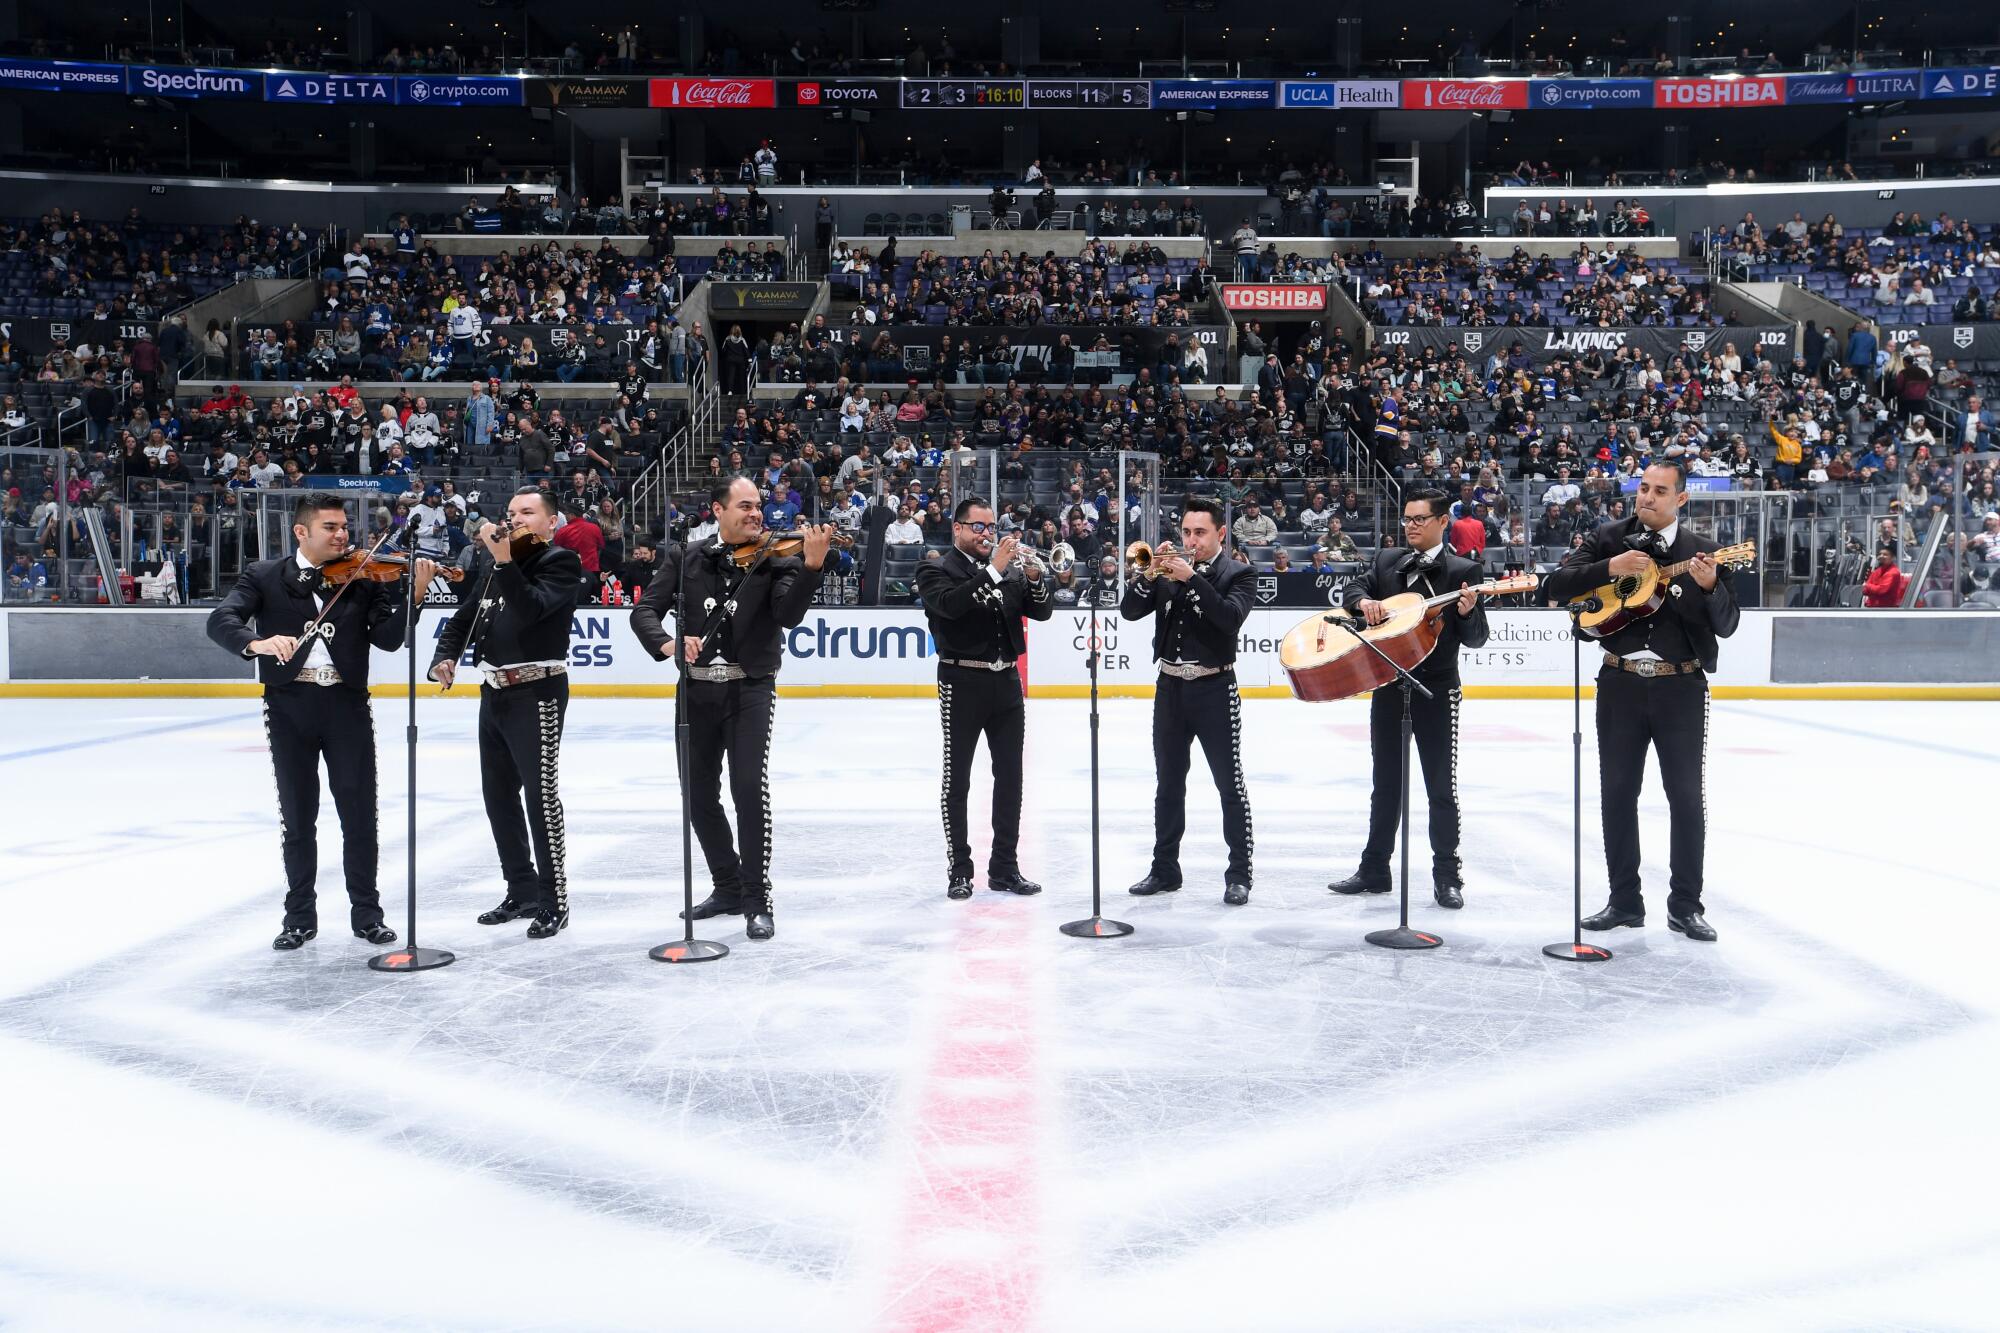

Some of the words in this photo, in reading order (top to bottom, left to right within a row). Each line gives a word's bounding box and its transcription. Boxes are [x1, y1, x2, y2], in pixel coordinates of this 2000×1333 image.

[63, 72, 119, 83] EXPRESS
[142, 69, 244, 92] Spectrum
[1857, 77, 1916, 94] ULTRA
[305, 81, 387, 98] DELTA
[432, 83, 509, 101] crypto.com
[685, 81, 754, 105] Coca-Cola
[824, 88, 878, 100] TOYOTA
[920, 88, 931, 103] 2
[956, 88, 966, 103] 3
[978, 91, 985, 103] 2
[986, 88, 1023, 103] 16:10
[1033, 89, 1072, 99] BLOCKS
[1081, 88, 1099, 103] 11
[1122, 88, 1132, 103] 5
[1159, 90, 1217, 99] AMERICAN
[1219, 90, 1269, 99] EXPRESS
[1291, 88, 1329, 101] UCLA
[1339, 88, 1393, 103] Health
[1438, 83, 1505, 106] Coca-Cola
[1564, 86, 1640, 104] crypto.com
[1661, 82, 1778, 103] TOSHIBA
[1789, 80, 1844, 97] Michelob
[1878, 190, 1894, 199] PR7
[1455, 203, 1469, 217] 32
[1226, 290, 1323, 307] TOSHIBA
[119, 326, 147, 339] 118
[1383, 332, 1410, 344] 102
[1759, 332, 1786, 345] 102
[1571, 332, 1627, 354] KINGS
[338, 478, 380, 488] Spectrum
[1315, 574, 1333, 588] GO
[1335, 575, 1357, 588] KIN
[1073, 616, 1118, 632] VAN
[1488, 622, 1553, 641] edicine
[781, 618, 926, 659] ctrum
[1073, 635, 1118, 651] COU
